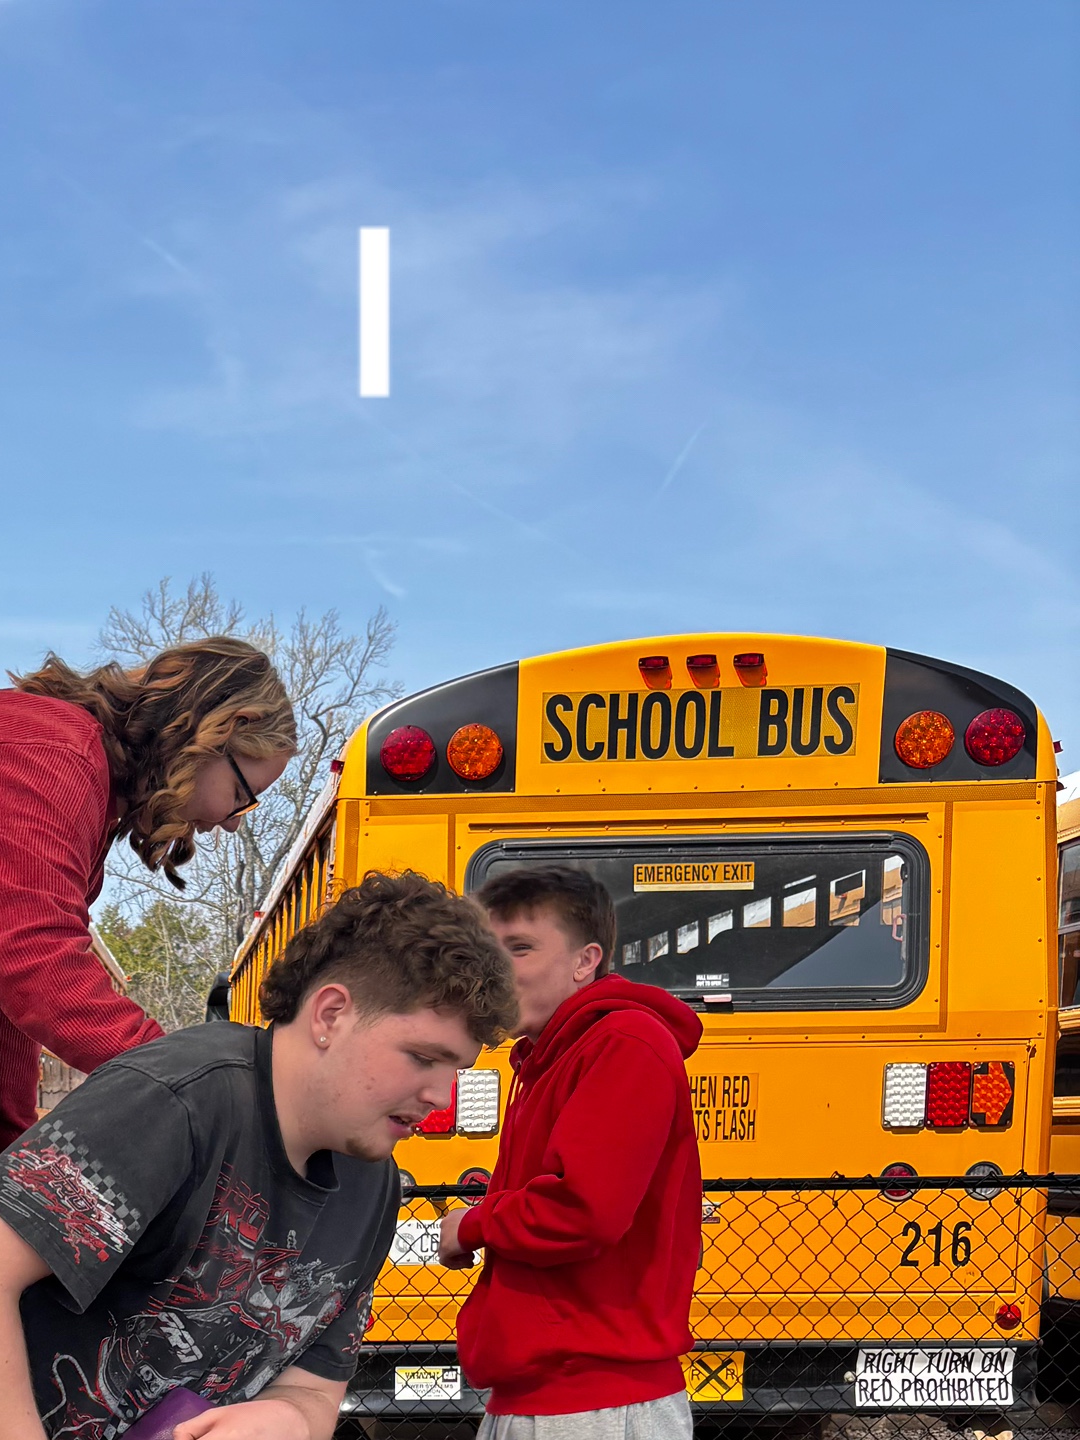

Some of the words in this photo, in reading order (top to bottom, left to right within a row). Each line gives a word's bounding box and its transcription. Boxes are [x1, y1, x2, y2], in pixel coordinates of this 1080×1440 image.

[543, 690, 735, 763] SCHOOL
[756, 686, 856, 757] BUS
[636, 864, 719, 882] EMERGENCY
[723, 863, 753, 881] EXIT
[689, 1075, 717, 1108] HEN
[722, 1075, 750, 1108] RED
[714, 1108, 756, 1141] FLASH
[900, 1221, 972, 1267] 216
[863, 1351, 919, 1374] RIGHT
[926, 1351, 976, 1374] TURN
[980, 1351, 1009, 1373] ON
[858, 1378, 893, 1402] RED
[900, 1377, 1010, 1402] PROHIBITED
